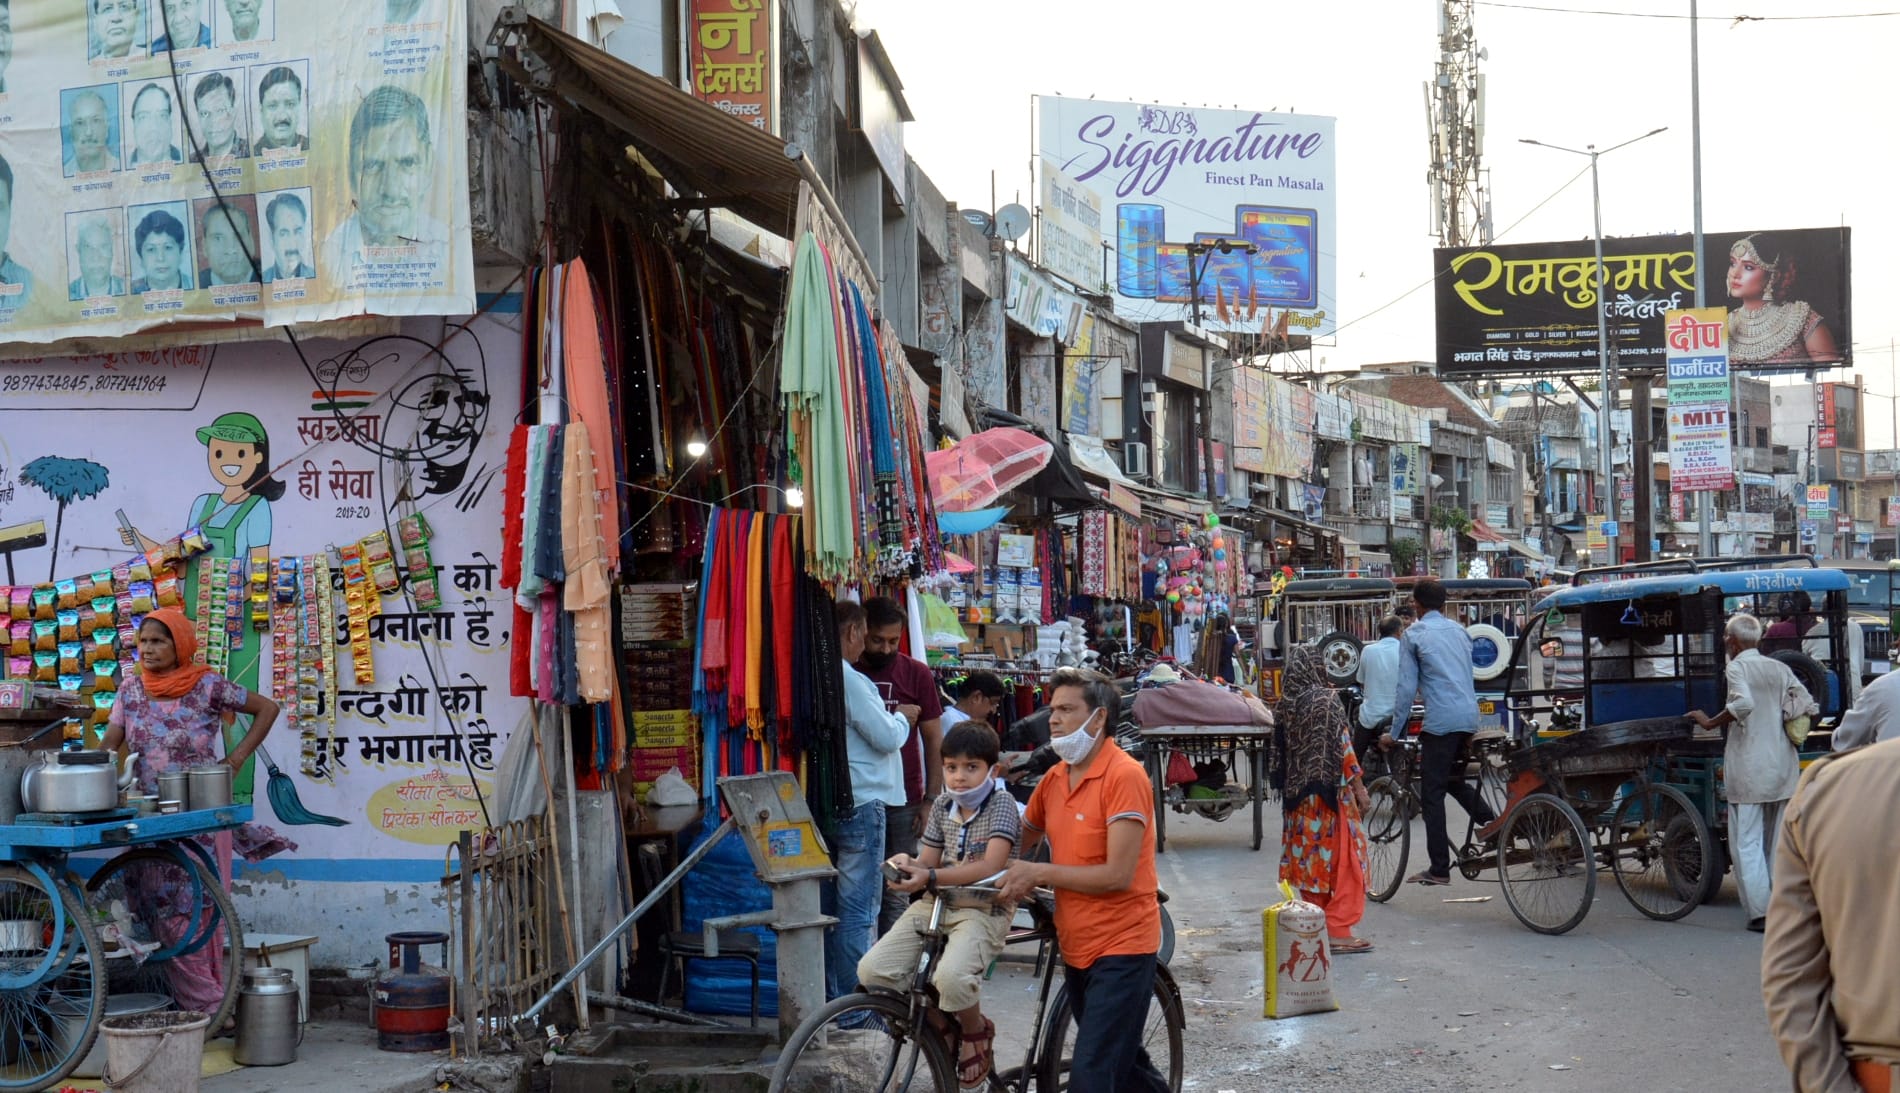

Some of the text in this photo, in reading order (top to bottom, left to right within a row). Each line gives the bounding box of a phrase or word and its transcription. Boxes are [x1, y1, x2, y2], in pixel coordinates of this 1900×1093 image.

[695, 49, 765, 93] टेलर्स
[1060, 113, 1323, 198] Siggnature
[1205, 171, 1325, 191] Finest Pan Masala
[1451, 251, 1695, 316] रामकुमार
[1668, 316, 1722, 352] दीप
[1453, 351, 1484, 363] भगत
[1486, 348, 1510, 362] सिंह
[1512, 347, 1532, 361] रोड
[1670, 358, 1725, 377] फर्नीचर
[297, 415, 381, 446] स्वच्छता
[1683, 411, 1726, 426] MIT
[298, 459, 375, 501] ही सेवा
[1808, 488, 1827, 500] दीप
[336, 506, 370, 519] 2019-20
[453, 552, 498, 592] को
[439, 673, 488, 715] को
[359, 735, 464, 763] भगाना
[467, 719, 498, 770] है
[396, 780, 436, 801] सीमा
[382, 803, 481, 829] प्रियंका सोनकर
